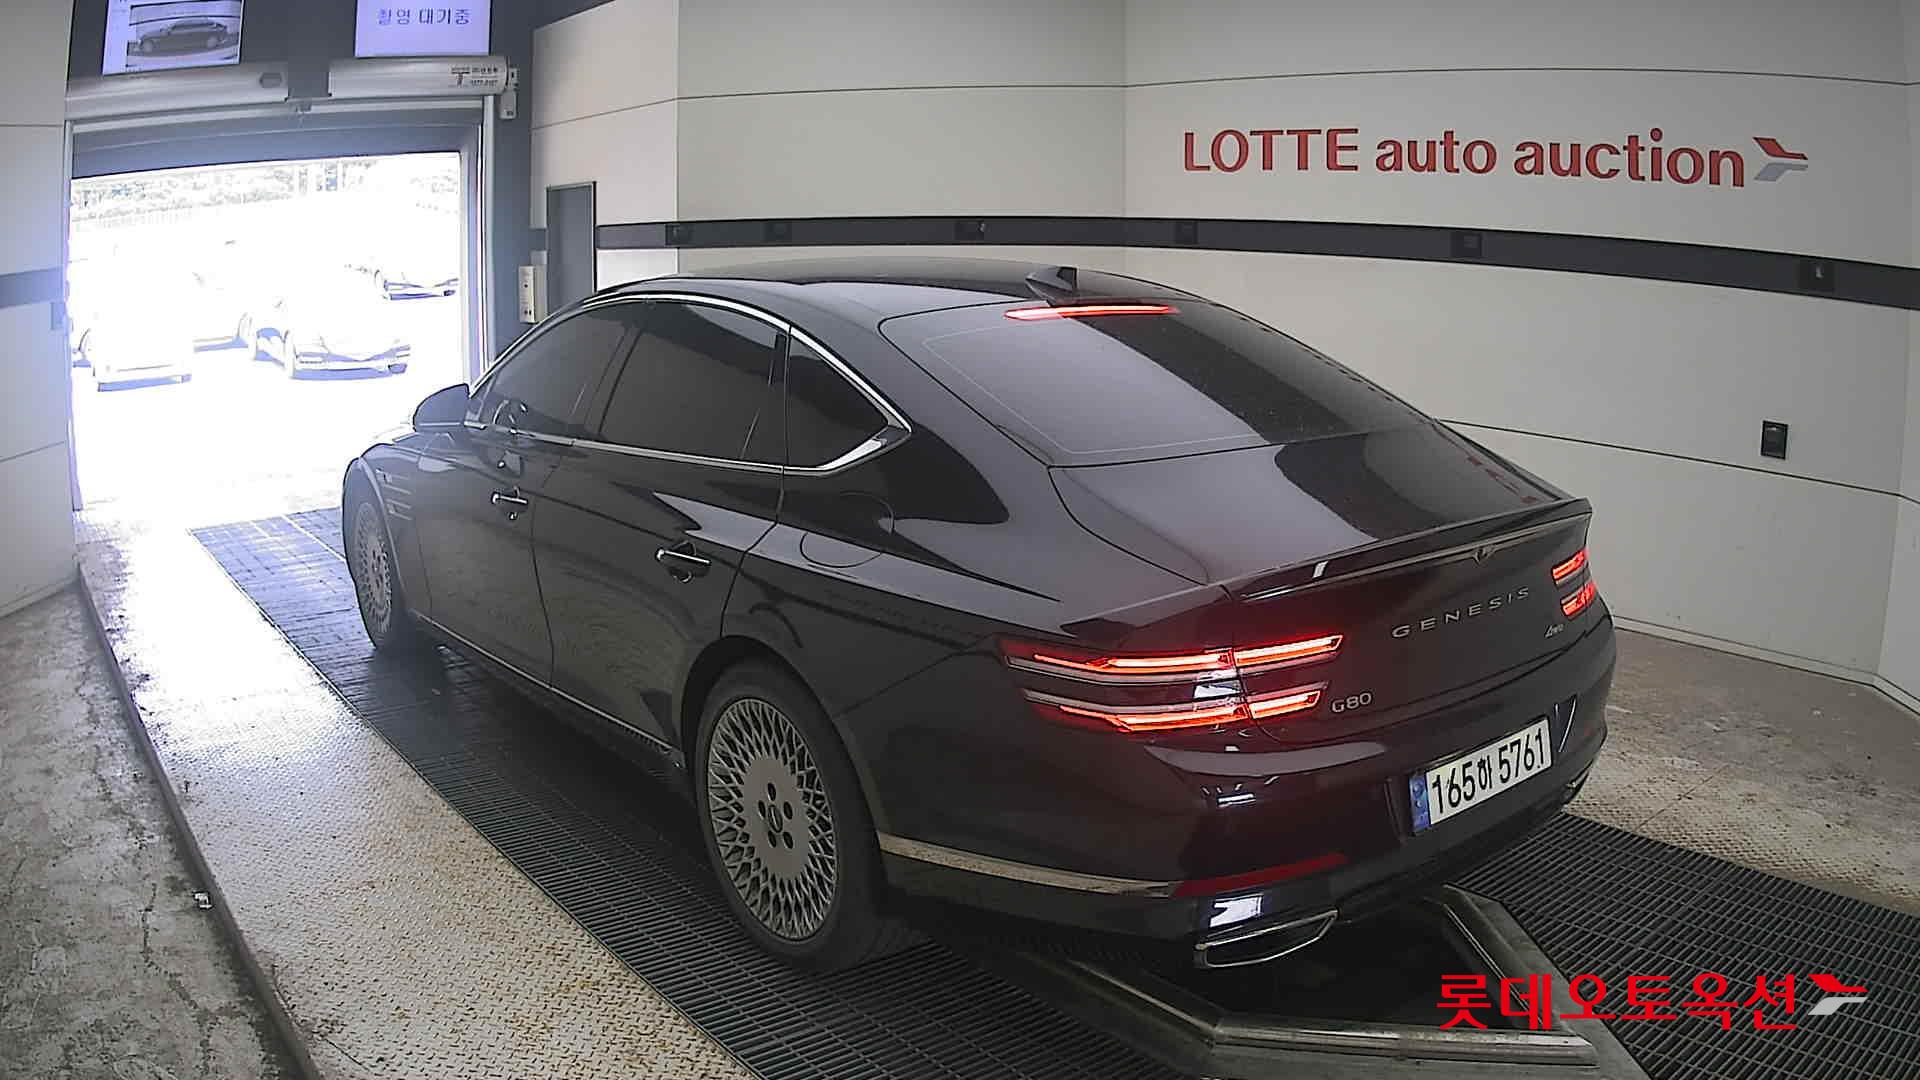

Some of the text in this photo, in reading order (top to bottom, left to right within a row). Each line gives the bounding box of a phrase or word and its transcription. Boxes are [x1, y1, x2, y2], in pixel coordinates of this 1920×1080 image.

[418, 8, 471, 25] 대기중
[1184, 127, 1745, 188] LOTTE auto auction
[1391, 586, 1530, 639] GENESIS
[1331, 691, 1373, 714] G80
[1431, 727, 1546, 815] 165하 5761
